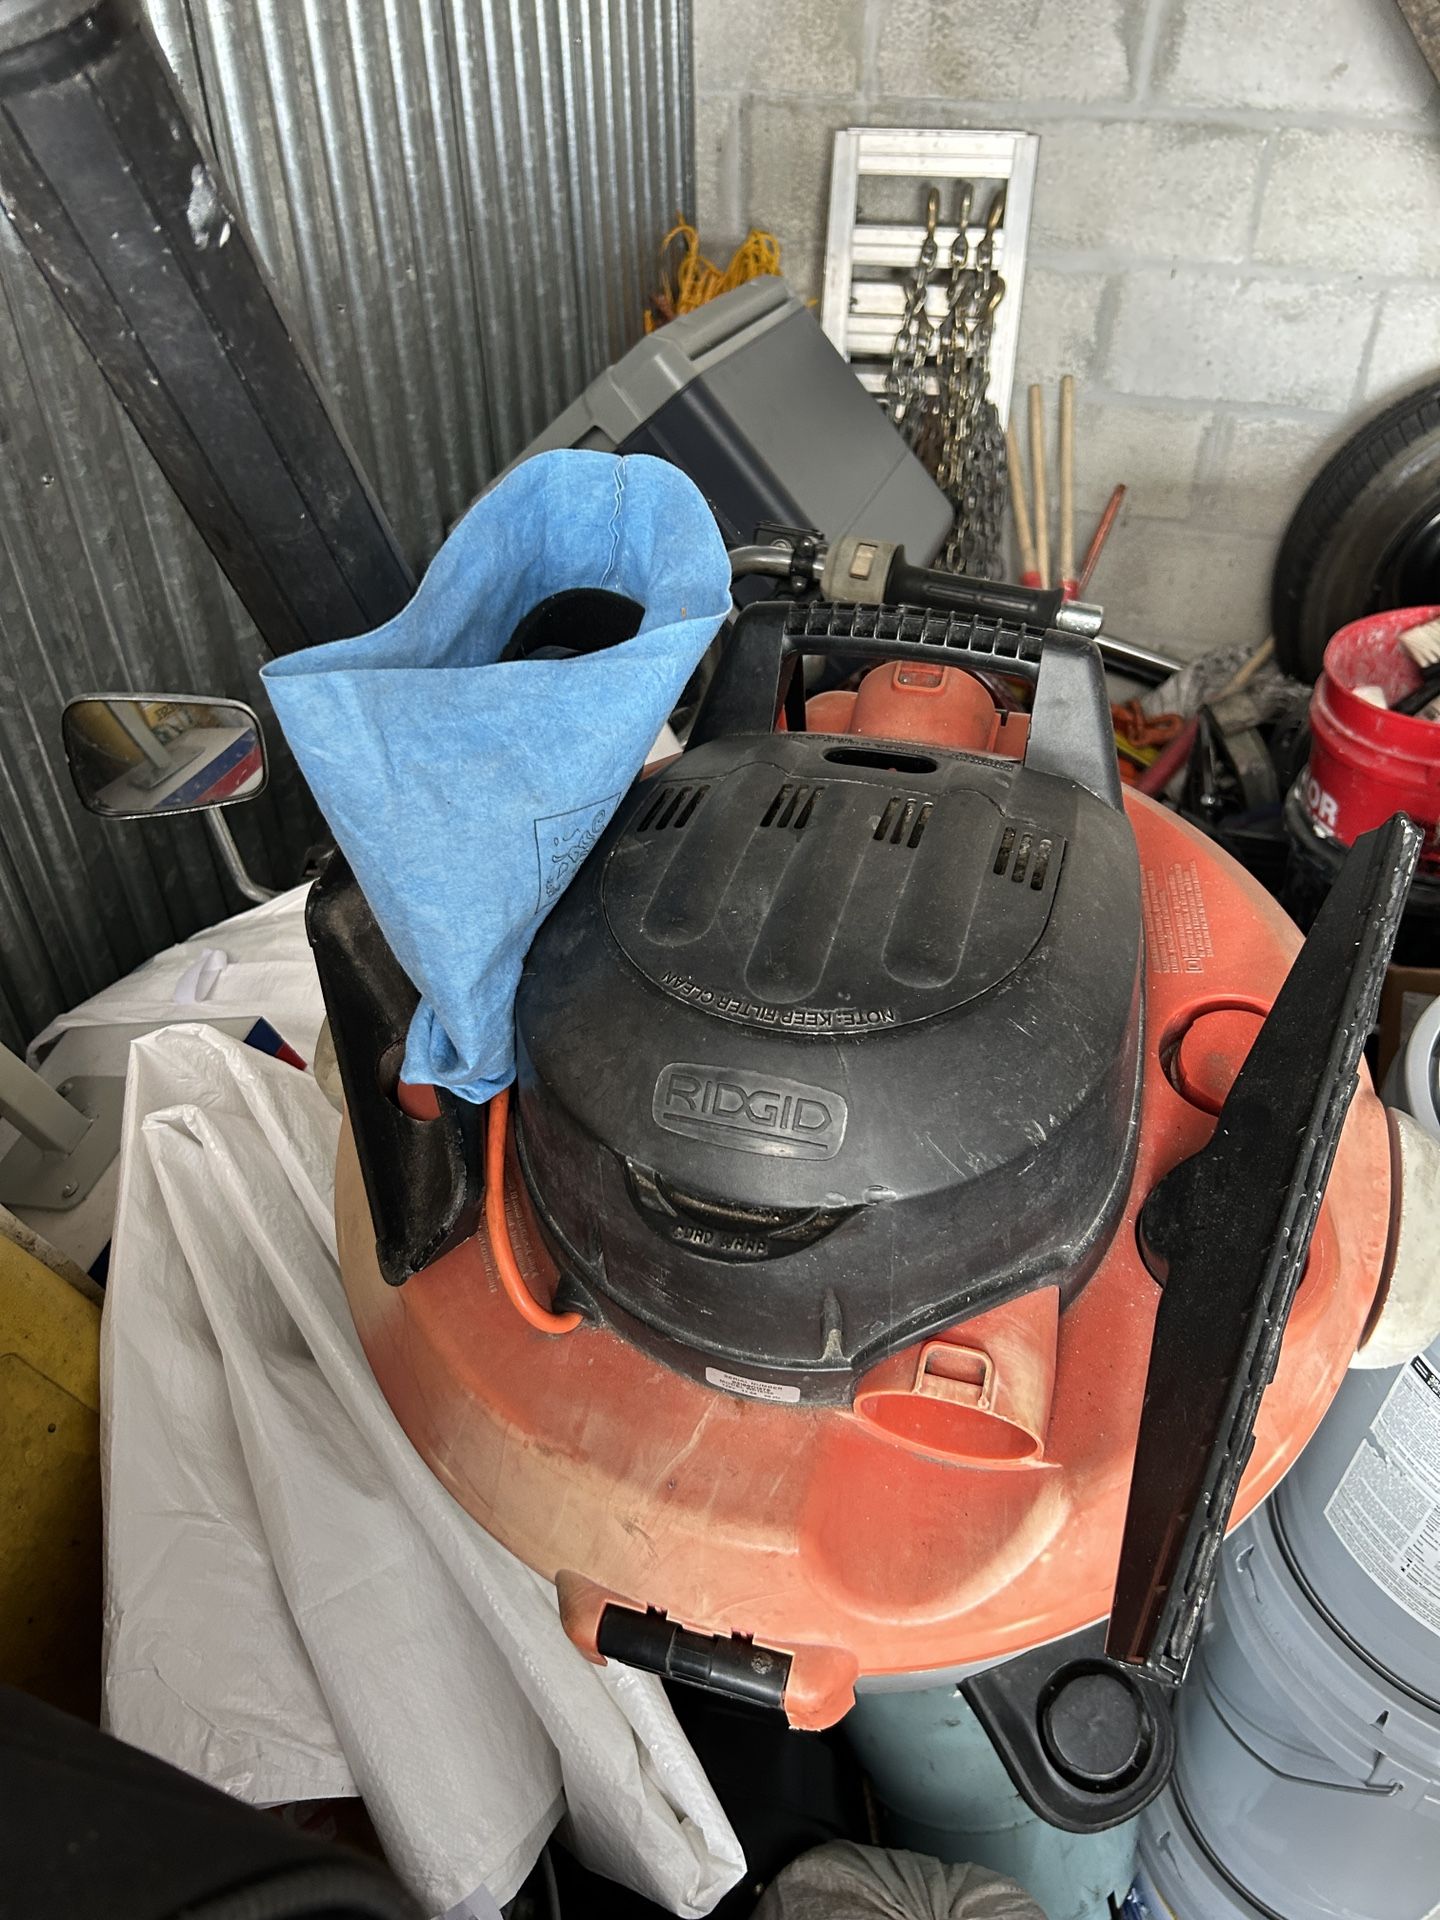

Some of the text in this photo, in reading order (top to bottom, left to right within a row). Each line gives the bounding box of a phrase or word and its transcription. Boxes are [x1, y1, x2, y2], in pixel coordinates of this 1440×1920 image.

[660, 970, 896, 1028] NOTE: KEEP FILTER CLEAN
[665, 1073, 833, 1135] RIDGID
